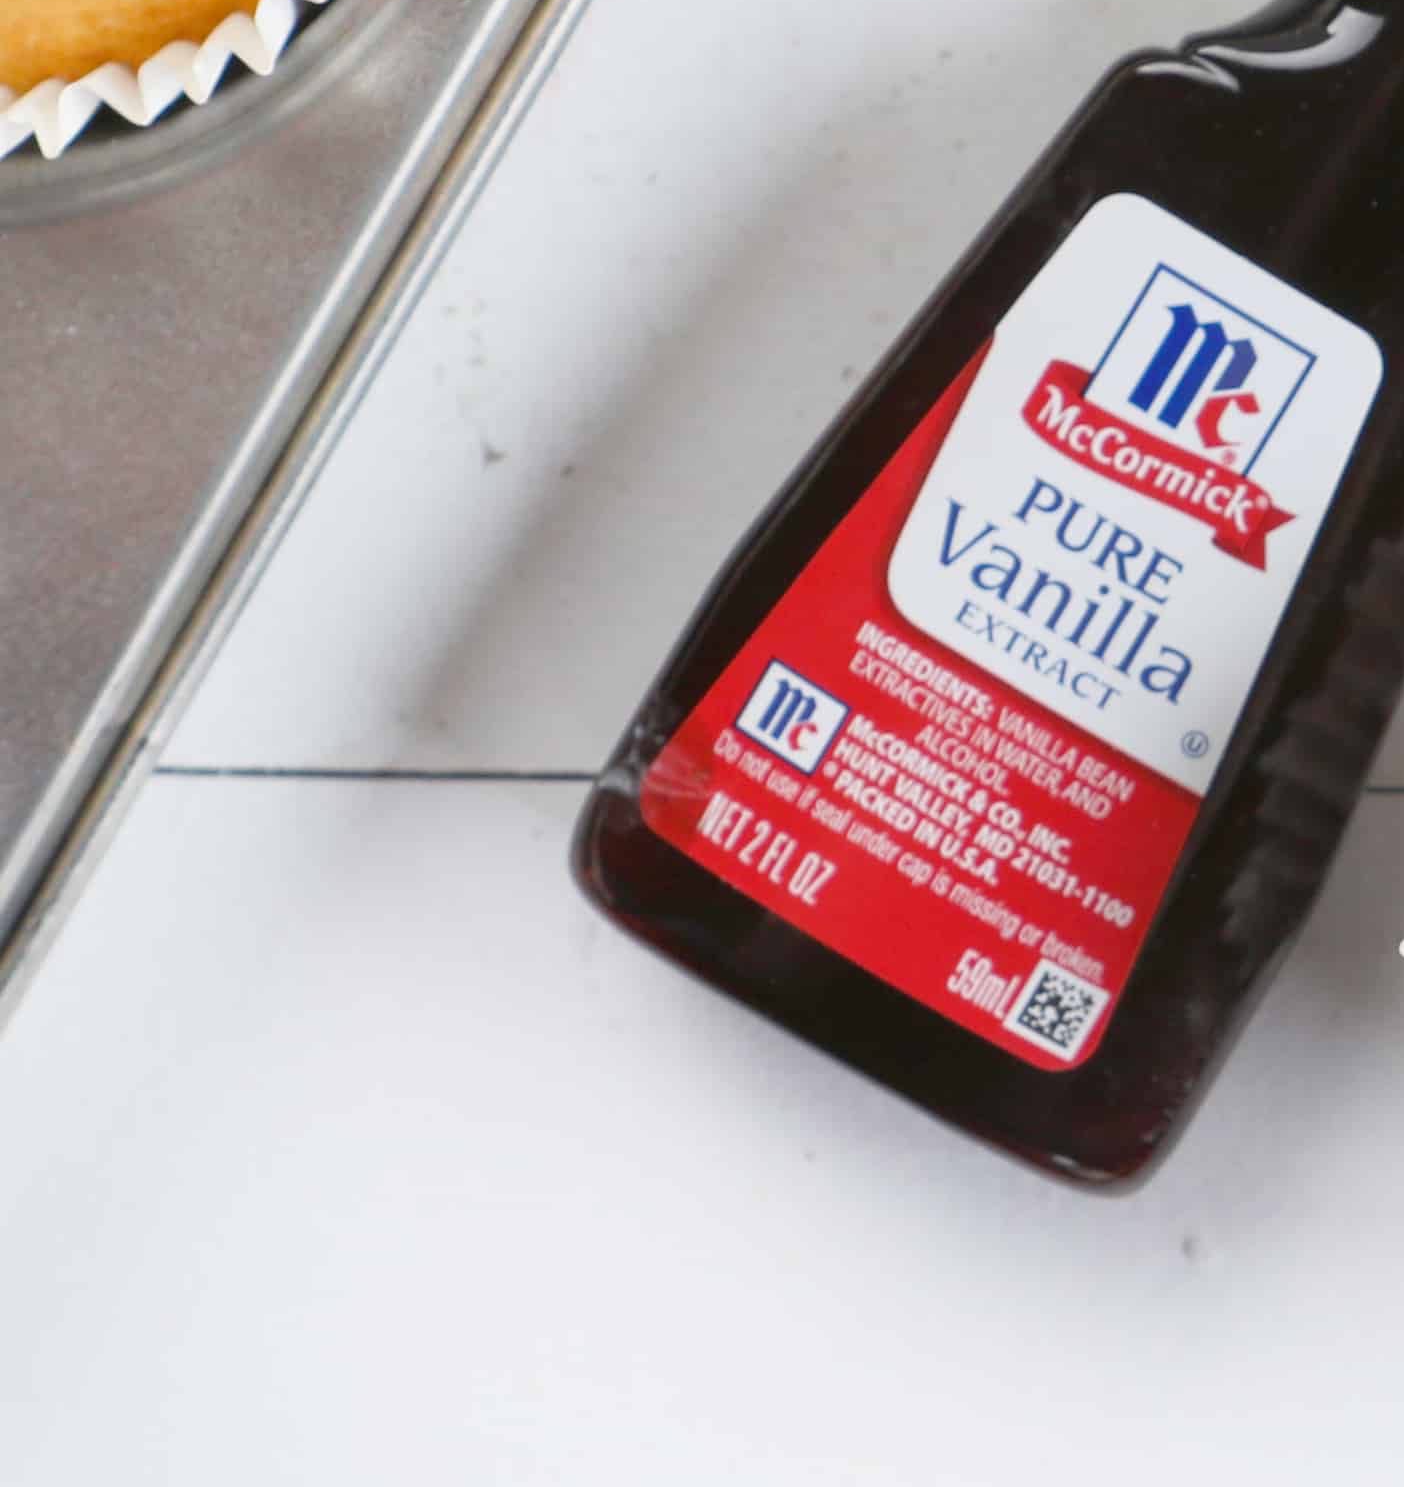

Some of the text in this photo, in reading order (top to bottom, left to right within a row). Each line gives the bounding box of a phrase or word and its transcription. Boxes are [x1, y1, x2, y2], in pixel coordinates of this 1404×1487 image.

[938, 498, 1195, 705] Vanilla
[1012, 477, 1185, 605] PURE
[856, 621, 1134, 801] INGREDIENTS: VANILLA BEAN
[954, 600, 1122, 711] EXTRACT
[847, 714, 973, 803] McCORMICK
[968, 789, 988, 814] &
[1027, 823, 1071, 863] INC.
[850, 649, 1111, 818] EXTRACTIVES IN WATER, AND
[915, 724, 1008, 794] ALCOHOL.
[698, 790, 836, 905] NET 2 FL OZ
[714, 729, 742, 762] Do
[739, 751, 772, 781] not
[767, 769, 801, 801] use
[798, 786, 819, 809] if
[812, 798, 853, 833] seal
[847, 821, 901, 862] under
[898, 852, 933, 884] cap
[931, 868, 951, 895] is
[950, 883, 1021, 938] missing
[1019, 924, 1044, 945] or
[833, 737, 1134, 926] HUNT VALLEY, MD 21031-1100
[834, 769, 998, 885] PACKED IN U.S.A.
